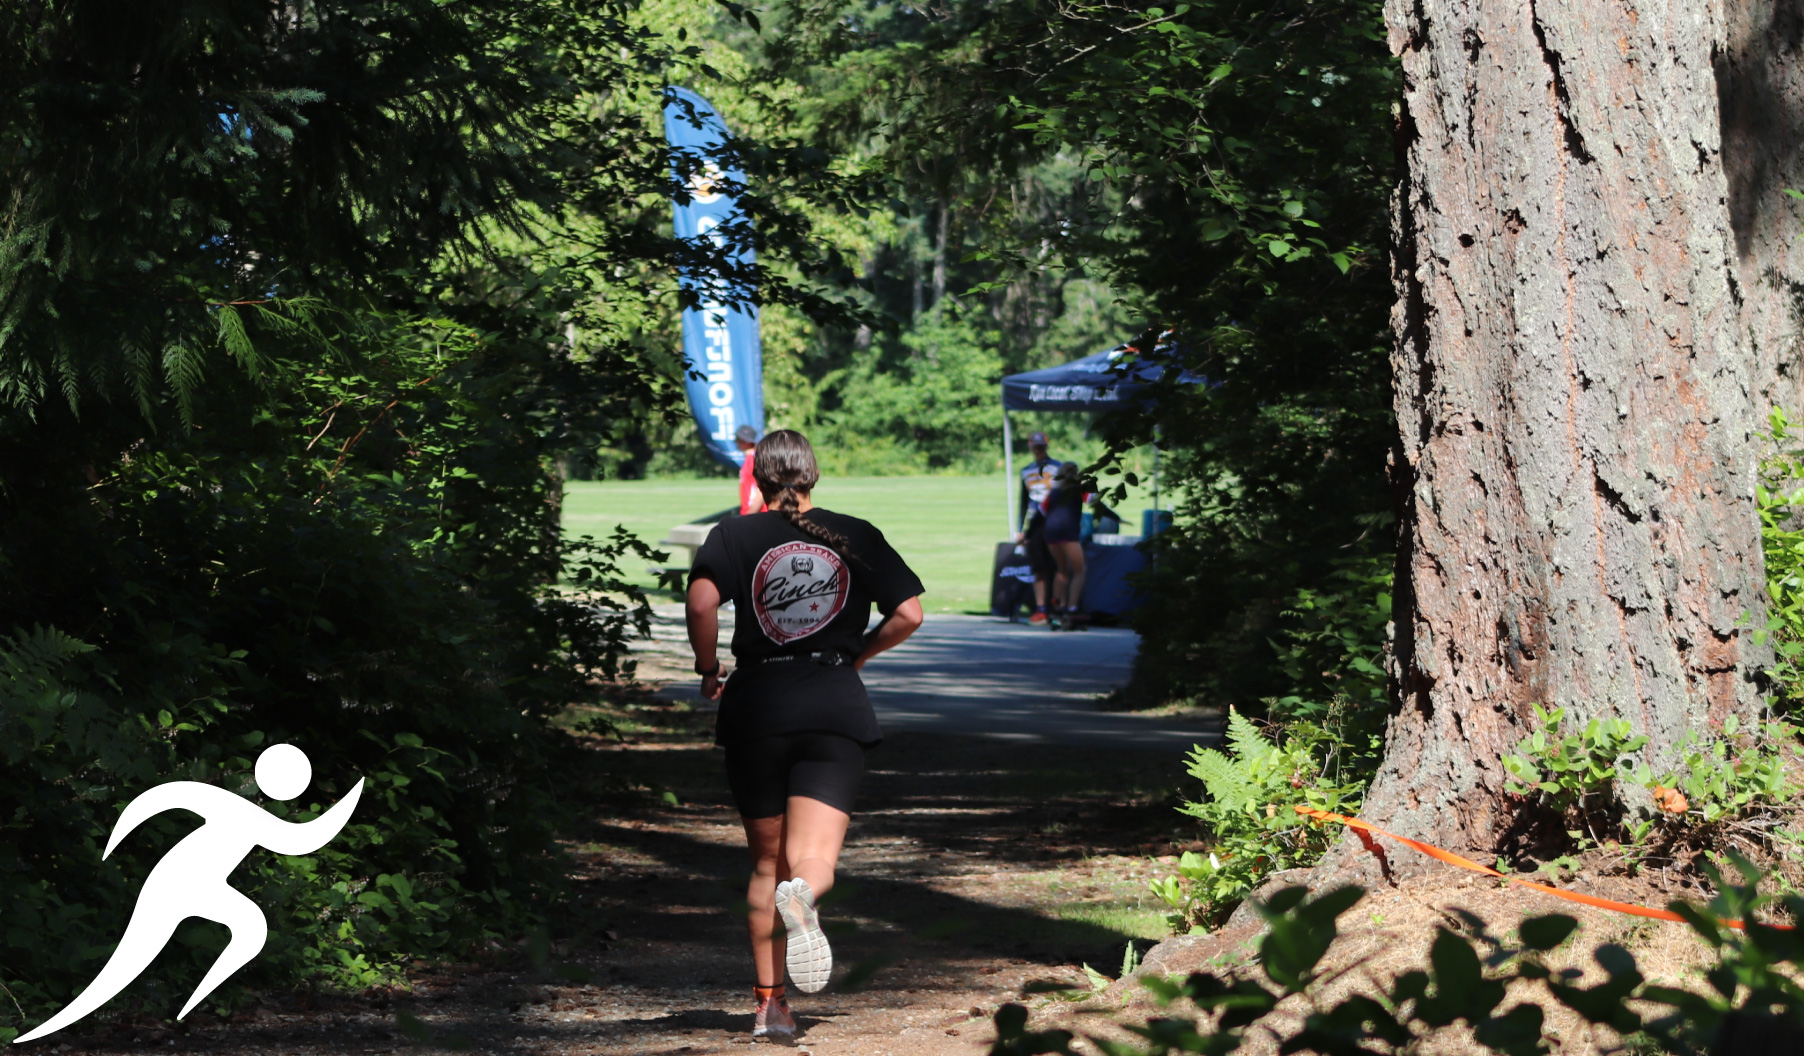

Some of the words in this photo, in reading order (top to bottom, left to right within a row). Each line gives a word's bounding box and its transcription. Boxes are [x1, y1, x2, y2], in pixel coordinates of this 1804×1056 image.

[761, 544, 806, 571] AMERICAN
[810, 547, 840, 567] BRAND
[757, 567, 845, 606] Cinch
